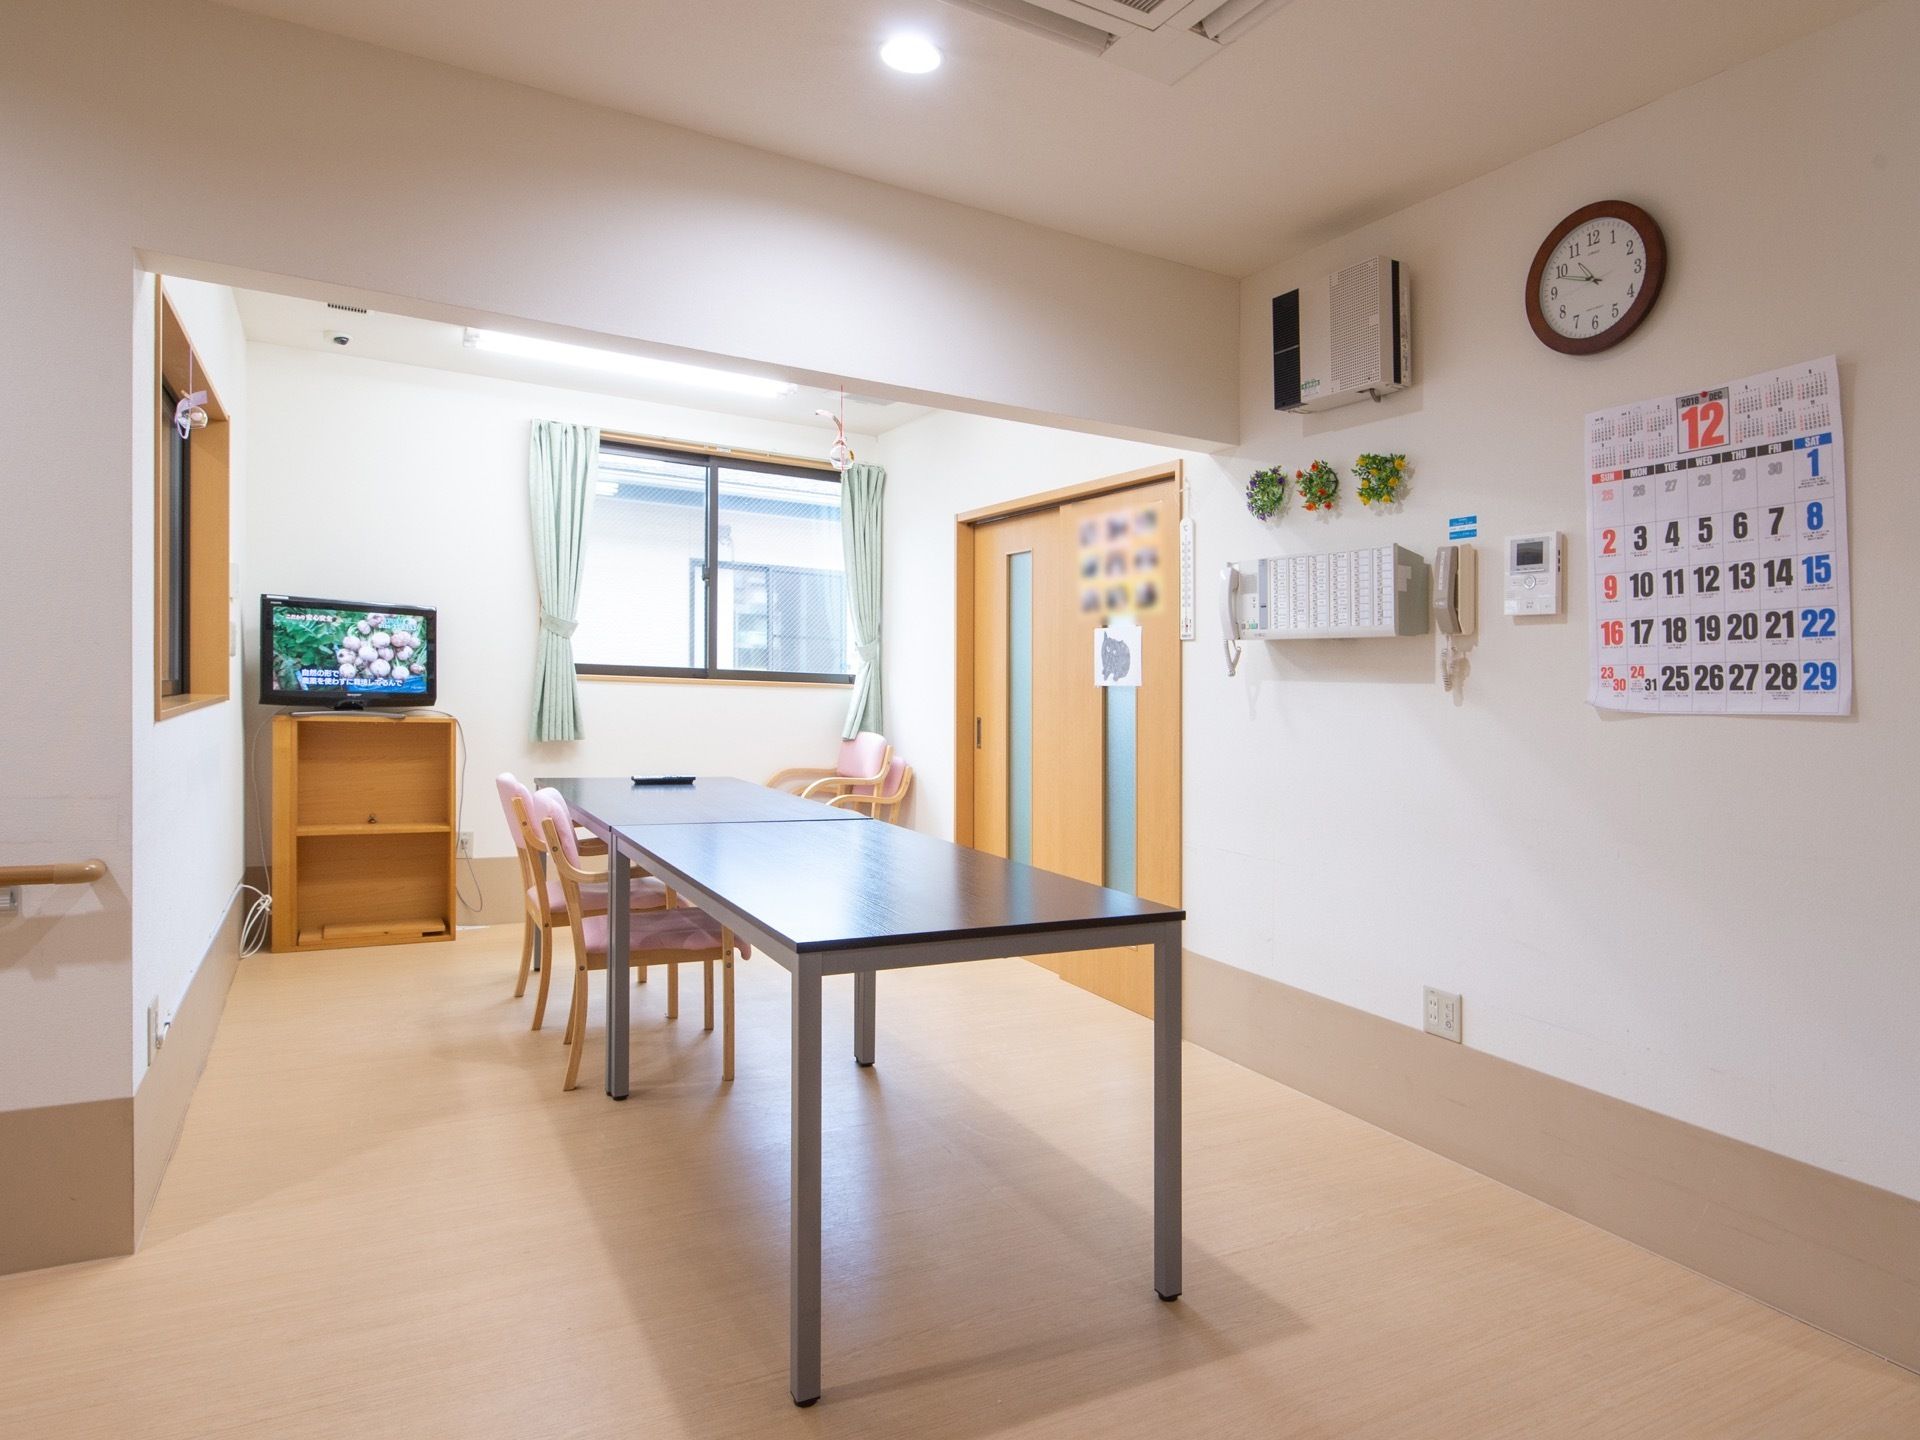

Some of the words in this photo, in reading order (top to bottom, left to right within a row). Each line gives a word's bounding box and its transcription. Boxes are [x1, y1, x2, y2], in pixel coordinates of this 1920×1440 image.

[1587, 229, 1600, 247] 12
[1609, 230, 1616, 245] 1
[1569, 243, 1581, 259] 11
[1626, 240, 1634, 255] 2
[1556, 263, 1568, 279] 10
[1634, 258, 1642, 273] 3
[1551, 287, 1558, 300] 9
[1627, 283, 1635, 298] 4
[1559, 305, 1567, 319] 8
[1611, 303, 1619, 318] 5
[1573, 315, 1580, 329] 7
[1591, 315, 1599, 329] 6
[1681, 396, 1699, 408] 2018
[1709, 391, 1723, 401] DEC
[1681, 402, 1725, 449] 12
[1600, 472, 1615, 482] SUN
[1630, 467, 1648, 478] MON
[1664, 462, 1678, 472] TUE
[1695, 456, 1713, 466] WED
[1731, 450, 1747, 460] THU
[1768, 443, 1782, 454] FRI
[1805, 436, 1820, 446] SAT
[1665, 479, 1678, 492] 27
[1768, 462, 1782, 475] 30
[1807, 448, 1819, 477] 1
[1602, 529, 1616, 554] 2
[1633, 525, 1647, 550] 3
[1665, 521, 1680, 546] 4
[1698, 516, 1712, 543] 5
[1733, 512, 1748, 539] 6
[1768, 507, 1784, 535] 7
[1806, 501, 1824, 530] 8
[1604, 575, 1618, 600] 9
[1629, 571, 1654, 598] 10
[1662, 568, 1684, 595] 11
[1693, 565, 1720, 593] 12
[1729, 562, 1756, 590] 13
[1763, 558, 1793, 587] 14
[1801, 554, 1832, 584] 15
[1600, 620, 1623, 646] 16
[1630, 619, 1654, 645] 17
[1662, 617, 1687, 643] 18
[1695, 615, 1721, 642] 19
[1727, 612, 1758, 640] 20
[1765, 610, 1794, 639] 21
[1801, 608, 1836, 638] 22
[1601, 666, 1614, 679] 23
[1630, 665, 1645, 679] 24
[1661, 665, 1689, 691] 25
[1694, 664, 1724, 691] 26
[1729, 664, 1759, 691] 27
[1765, 662, 1797, 691] 28
[1802, 662, 1837, 690] 29
[1613, 678, 1626, 691] 30
[1644, 678, 1657, 691] 31
